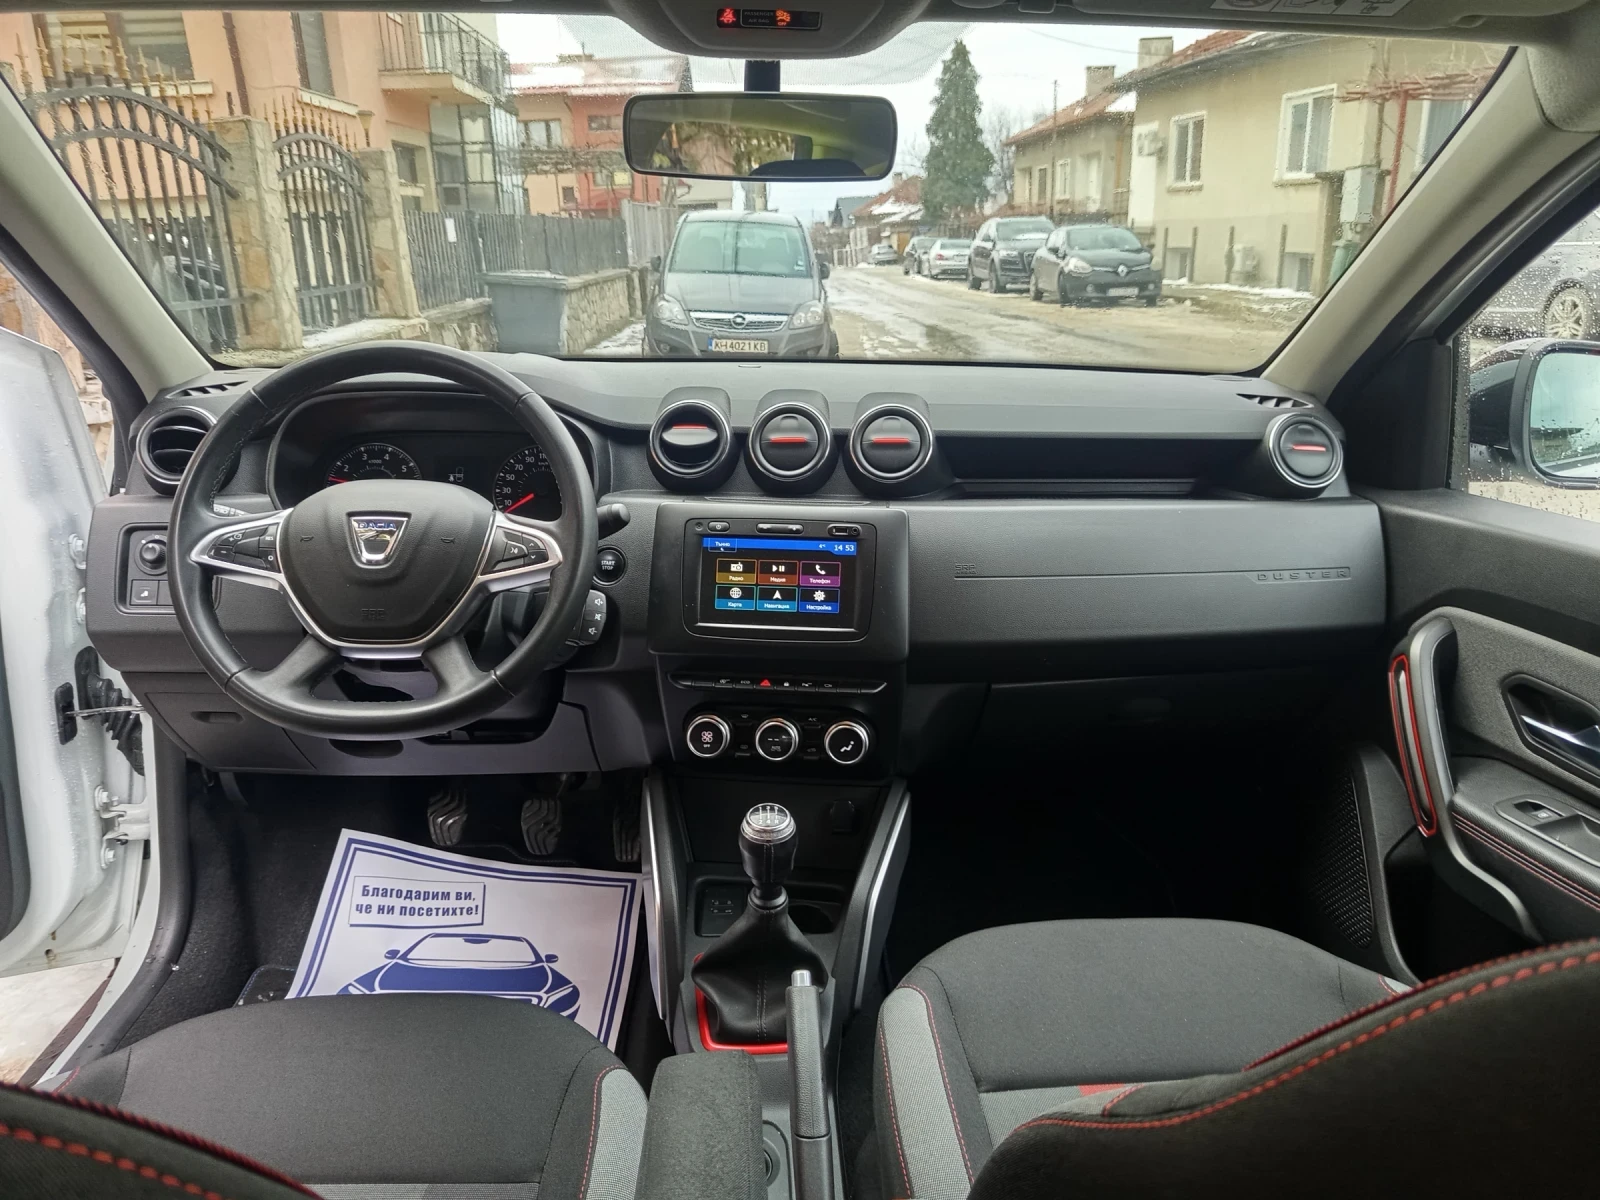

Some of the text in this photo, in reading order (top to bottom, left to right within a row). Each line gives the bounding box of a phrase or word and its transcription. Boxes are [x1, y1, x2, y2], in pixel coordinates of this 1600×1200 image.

[361, 453, 368, 461] 3
[383, 453, 390, 461] 4
[343, 464, 349, 472] 2
[401, 465, 407, 473] 5
[358, 521, 397, 530] DACIA
[834, 544, 854, 552] 14 53
[1257, 570, 1347, 581] DUSTER
[809, 577, 831, 585] Телефон
[727, 601, 743, 609] Карта
[361, 884, 476, 902] Благодарим ви,
[355, 903, 479, 917] че ни посетихте!
